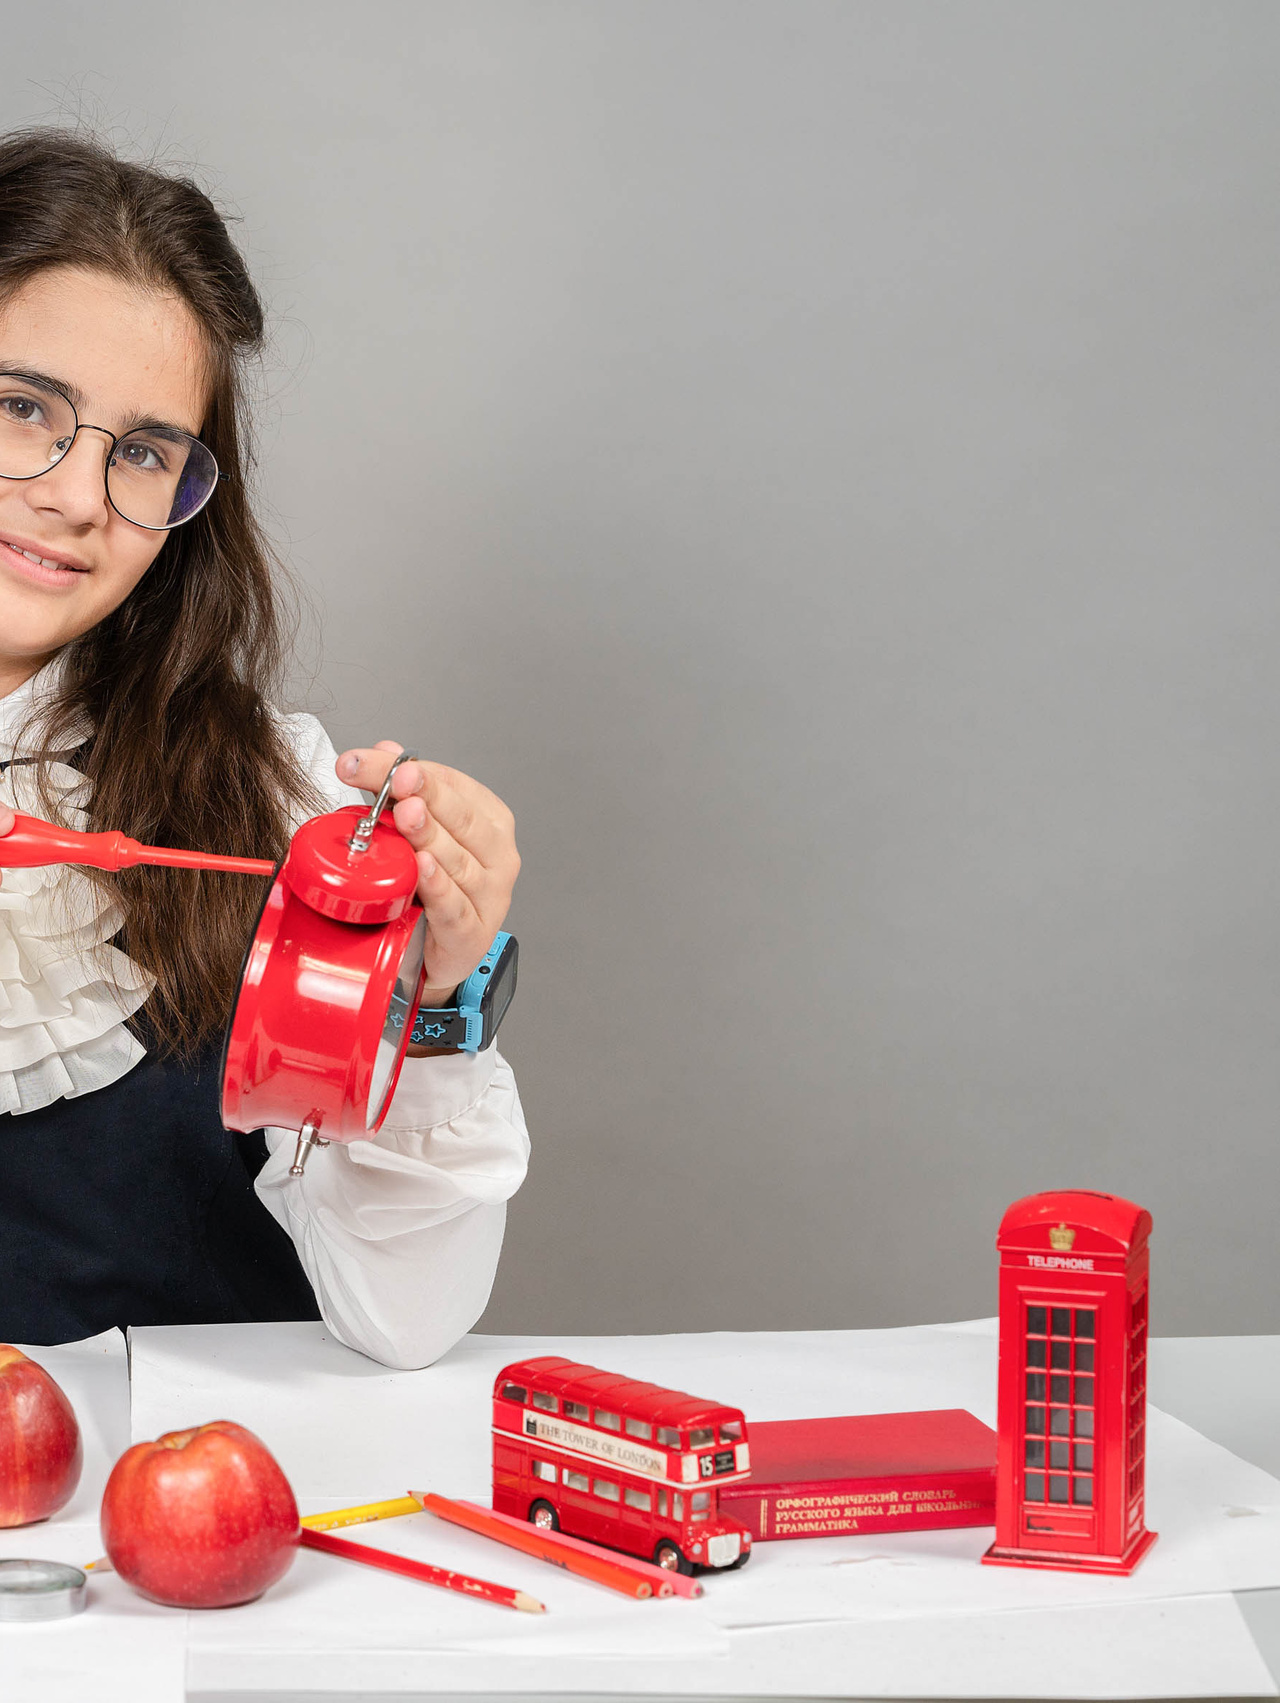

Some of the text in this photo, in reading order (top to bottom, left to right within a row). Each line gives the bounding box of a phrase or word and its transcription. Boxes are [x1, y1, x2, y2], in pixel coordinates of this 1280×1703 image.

[1026, 1255, 1094, 1270] TELEPHONE
[539, 1423, 662, 1472] THE TOWER OF LONDON
[700, 1455, 713, 1476] 15
[775, 1489, 957, 1510] ОРФОГРАФИЧЕСКИЙ СЛОВАРЬ
[775, 1507, 841, 1522] РУССКОГО
[843, 1505, 885, 1518] ЯЗЫКА
[886, 1504, 913, 1517] ДЛЯ
[775, 1519, 859, 1535] ГРАММАТИКА
